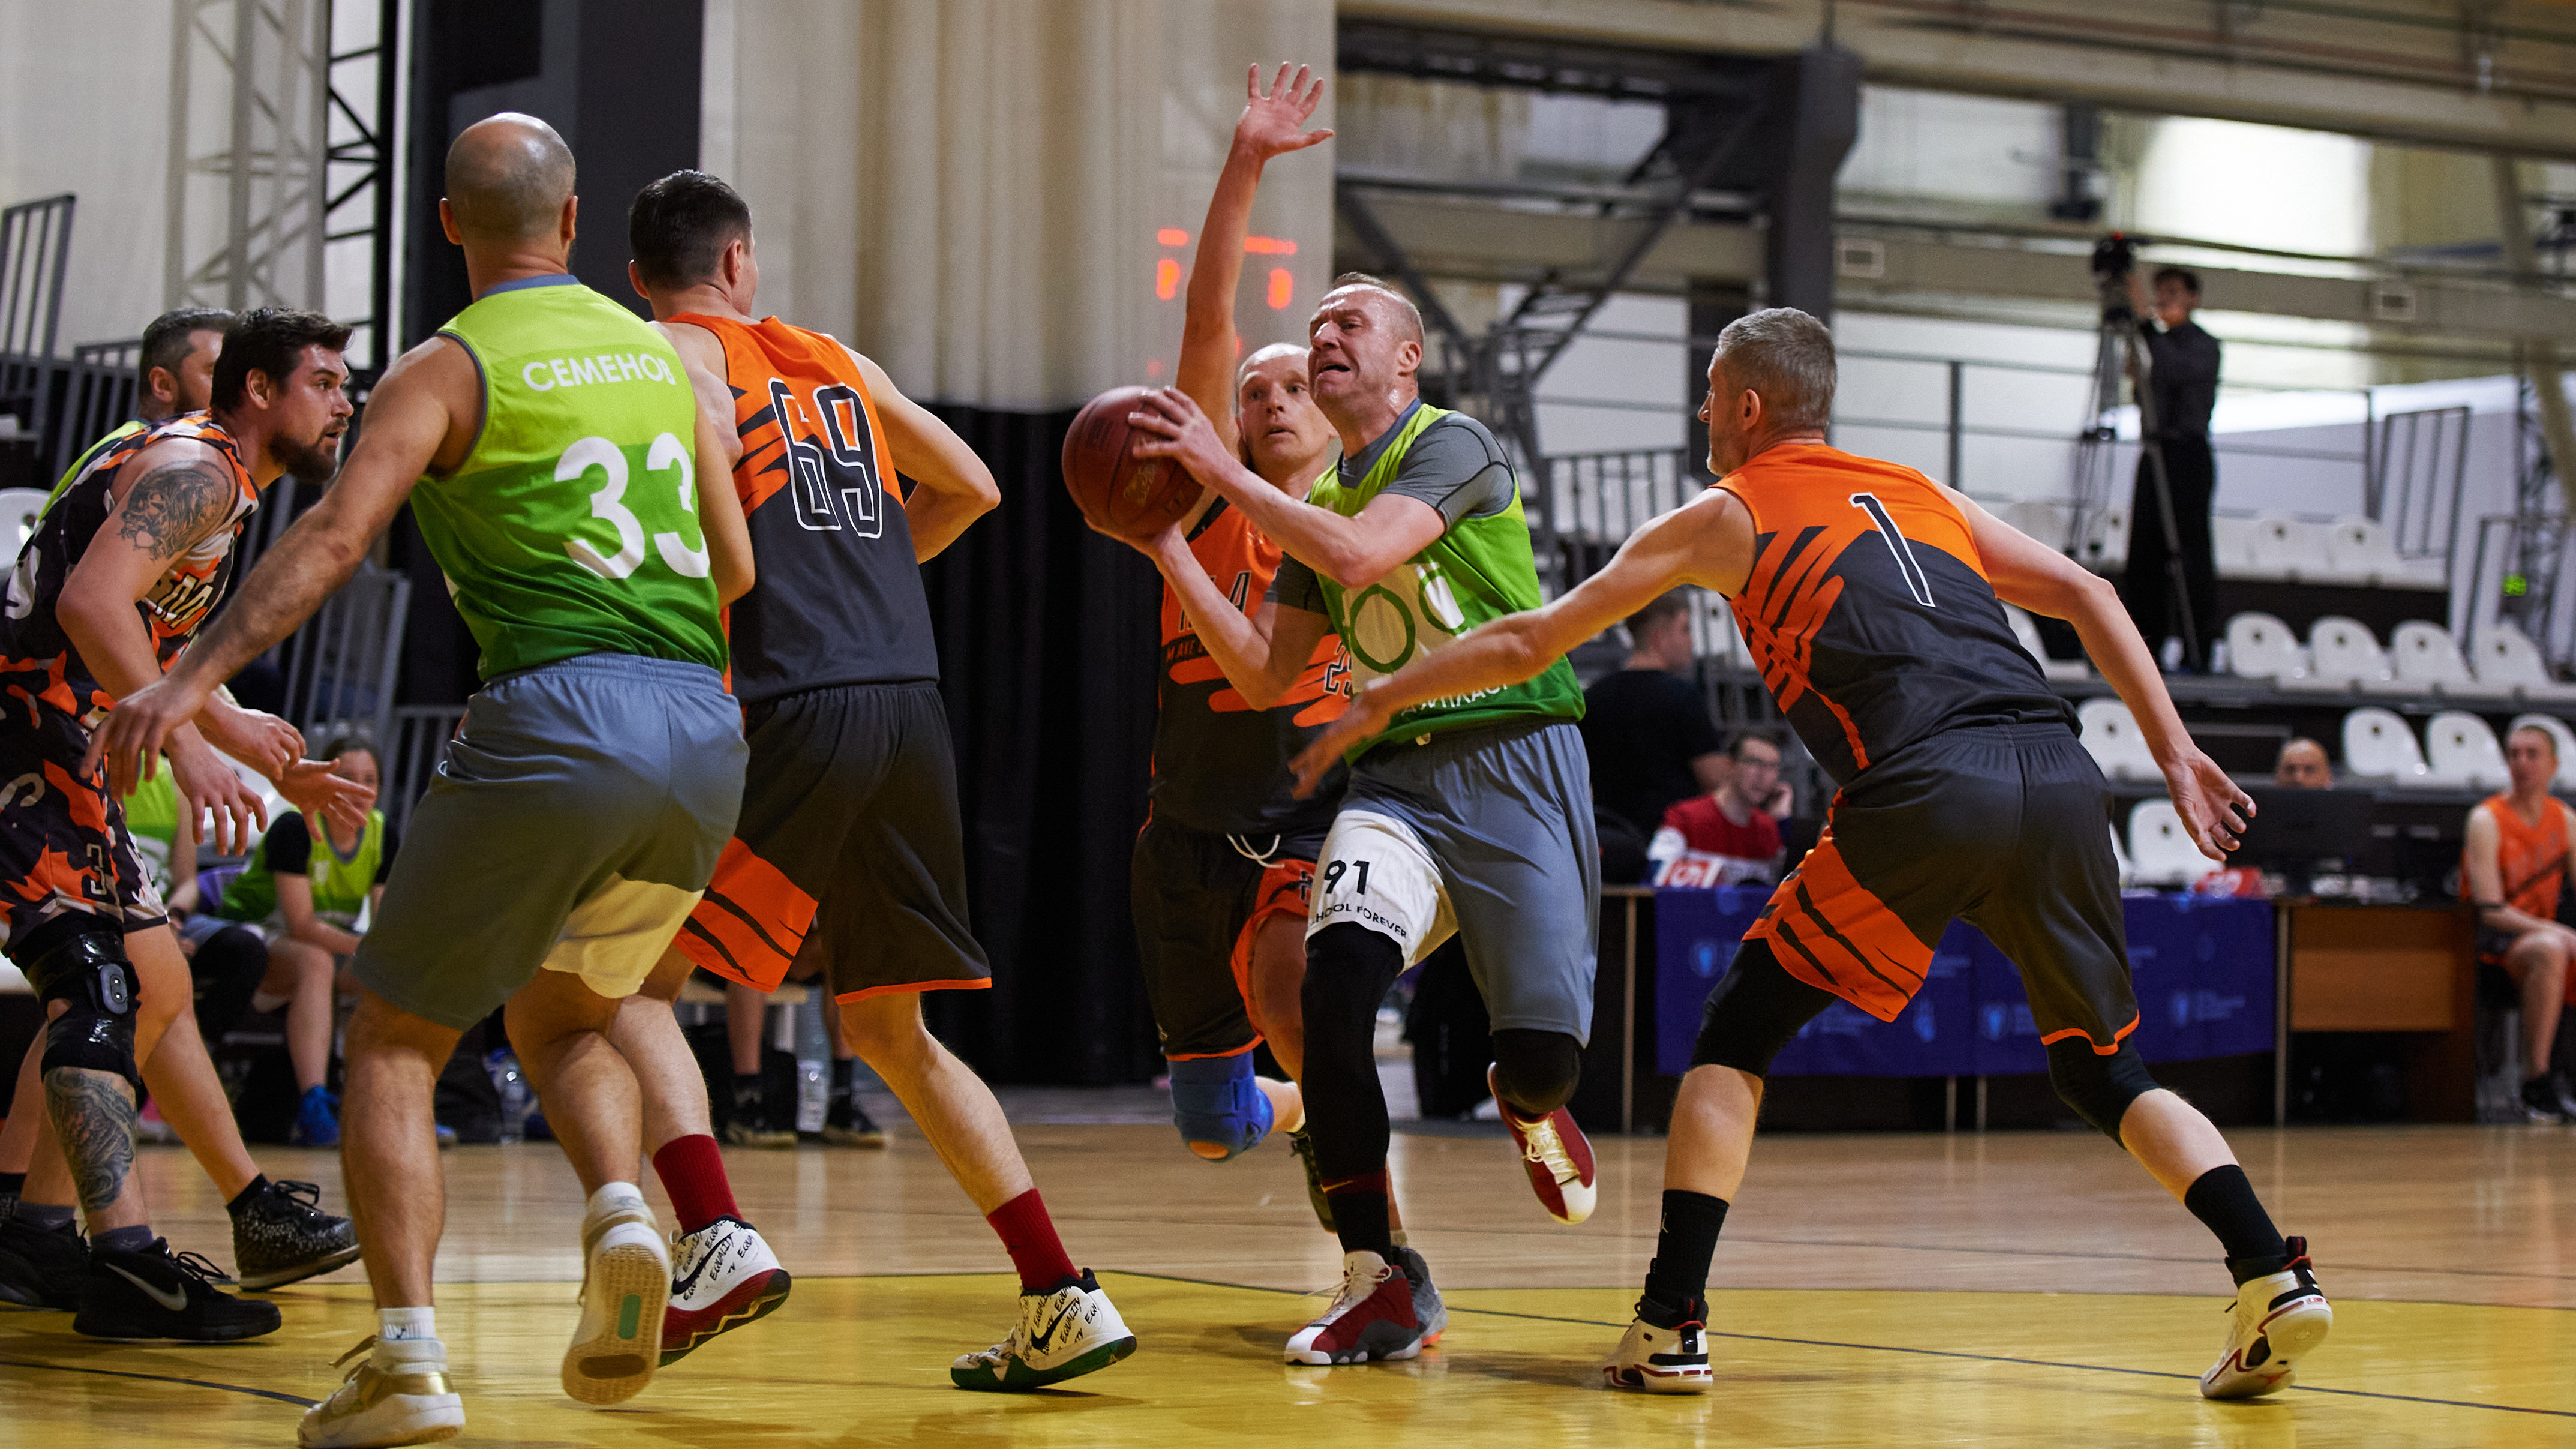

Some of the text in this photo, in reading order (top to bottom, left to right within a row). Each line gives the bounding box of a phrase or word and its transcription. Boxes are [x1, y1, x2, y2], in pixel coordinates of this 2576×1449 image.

[553, 431, 711, 579] 33
[767, 376, 882, 539] 69
[1848, 491, 1936, 608] 1
[1324, 860, 1370, 895] 91
[1356, 905, 1407, 938] FOREVER
